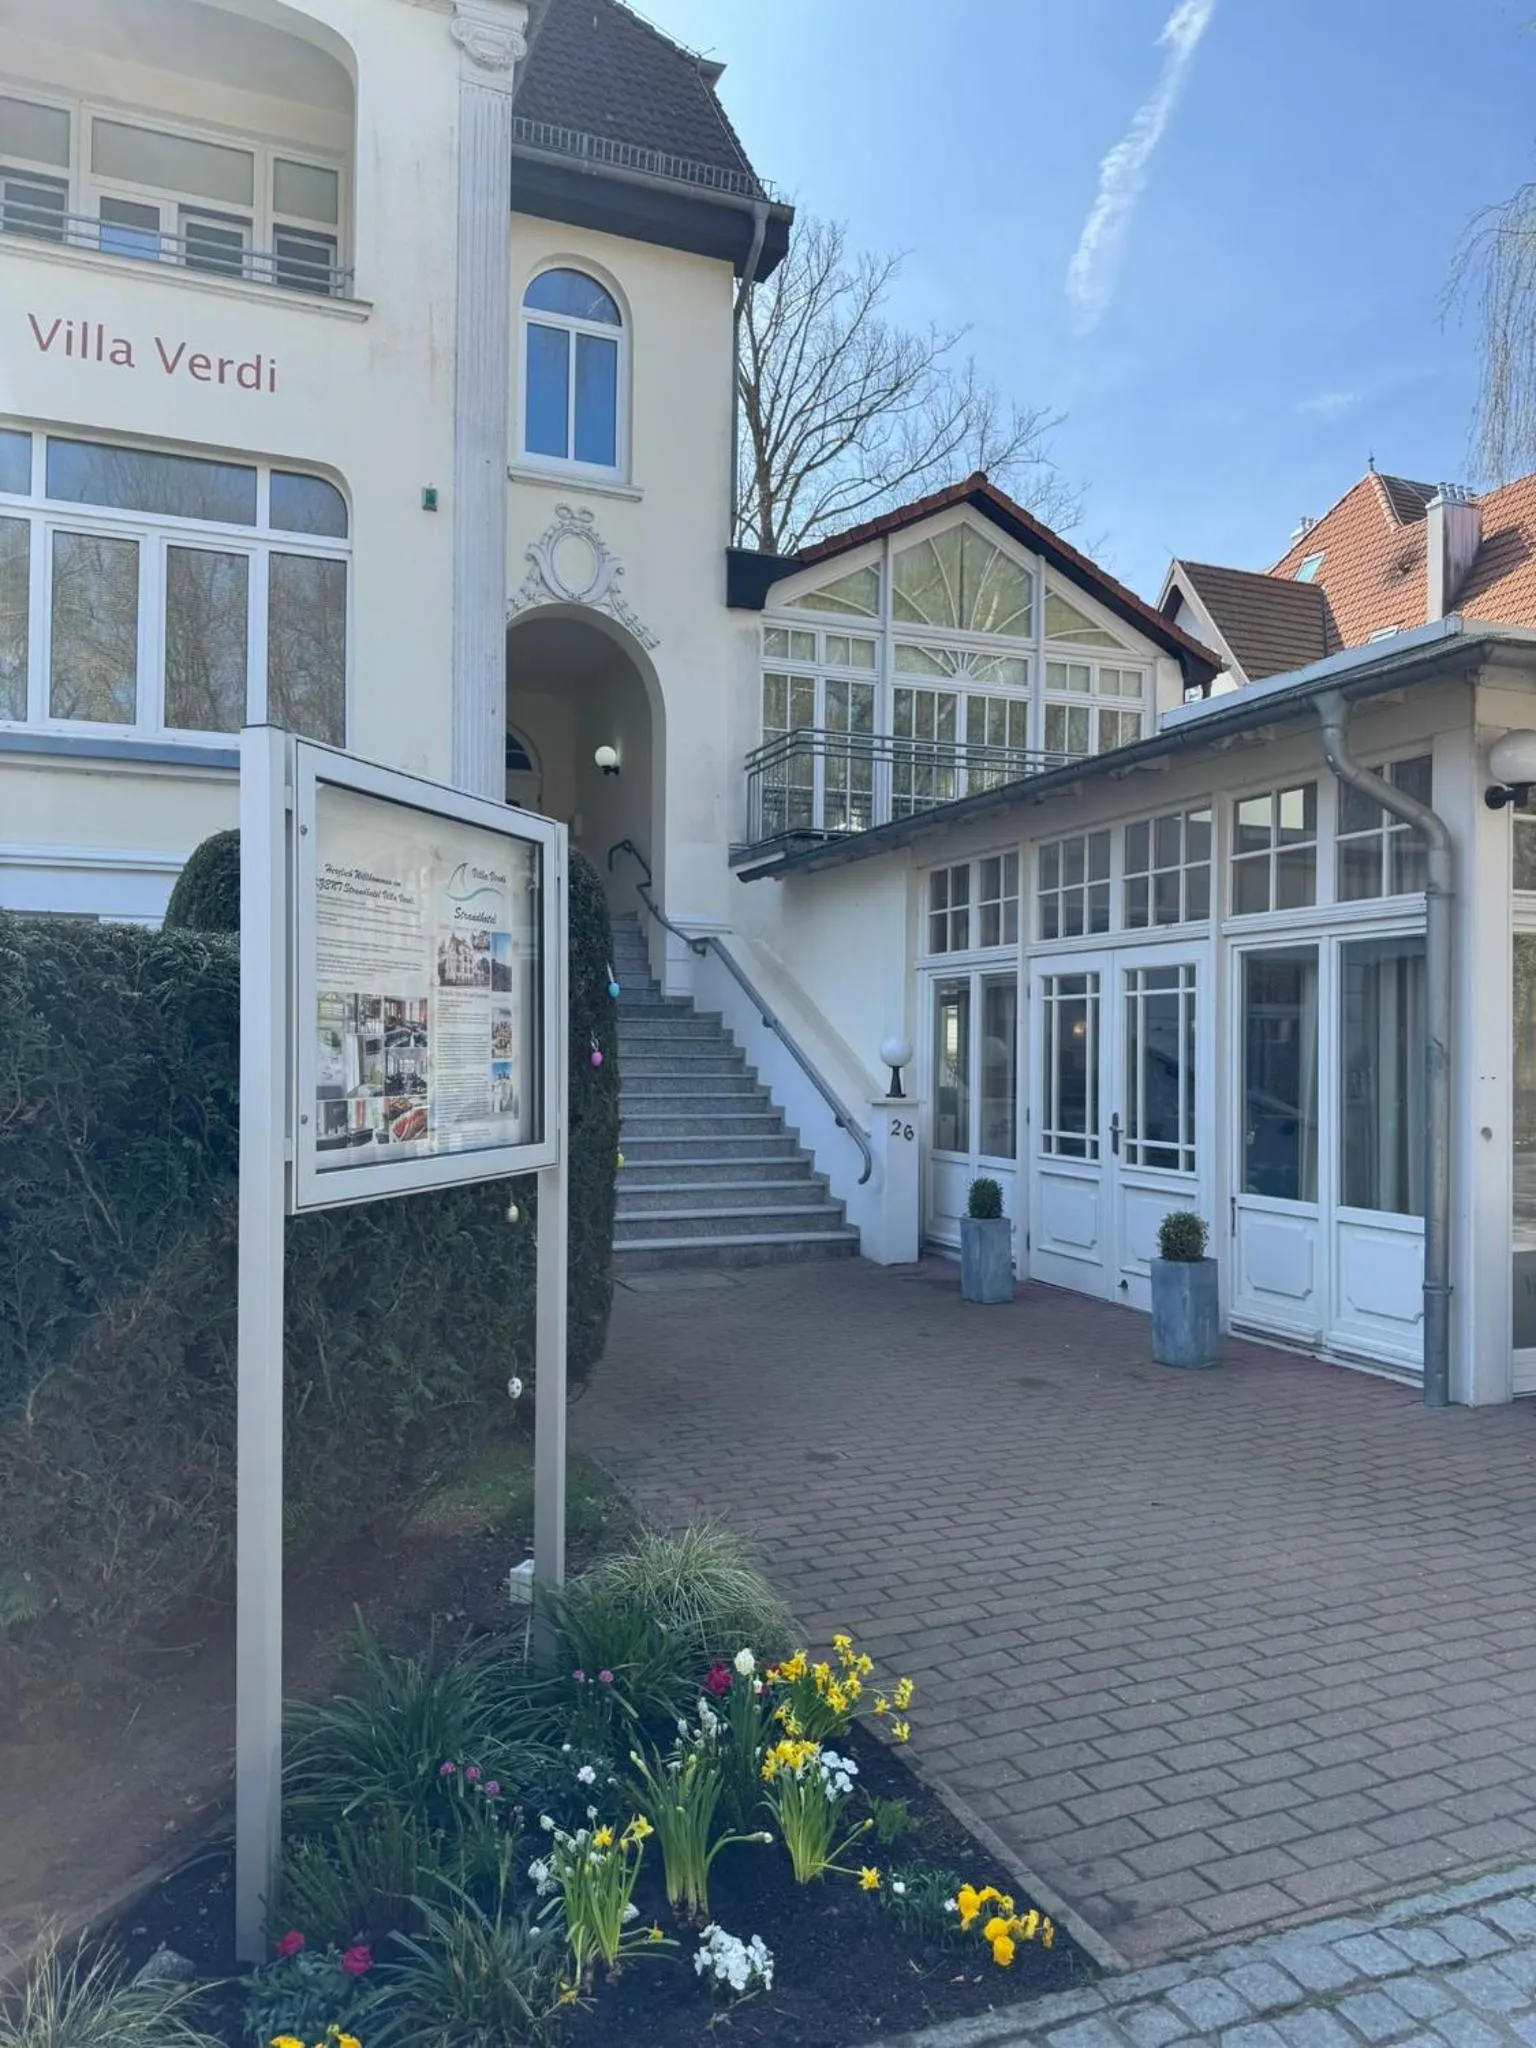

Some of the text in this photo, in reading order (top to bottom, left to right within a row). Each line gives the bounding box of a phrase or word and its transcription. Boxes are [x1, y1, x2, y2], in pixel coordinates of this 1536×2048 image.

[27, 312, 277, 394] Villa Verdi
[354, 868, 392, 885] Willkommen
[471, 866, 488, 880] Villa
[343, 882, 381, 899] Strandhotel
[382, 889, 397, 902] Villa
[454, 906, 498, 926] Strandhotel
[891, 1118, 915, 1142] 26
